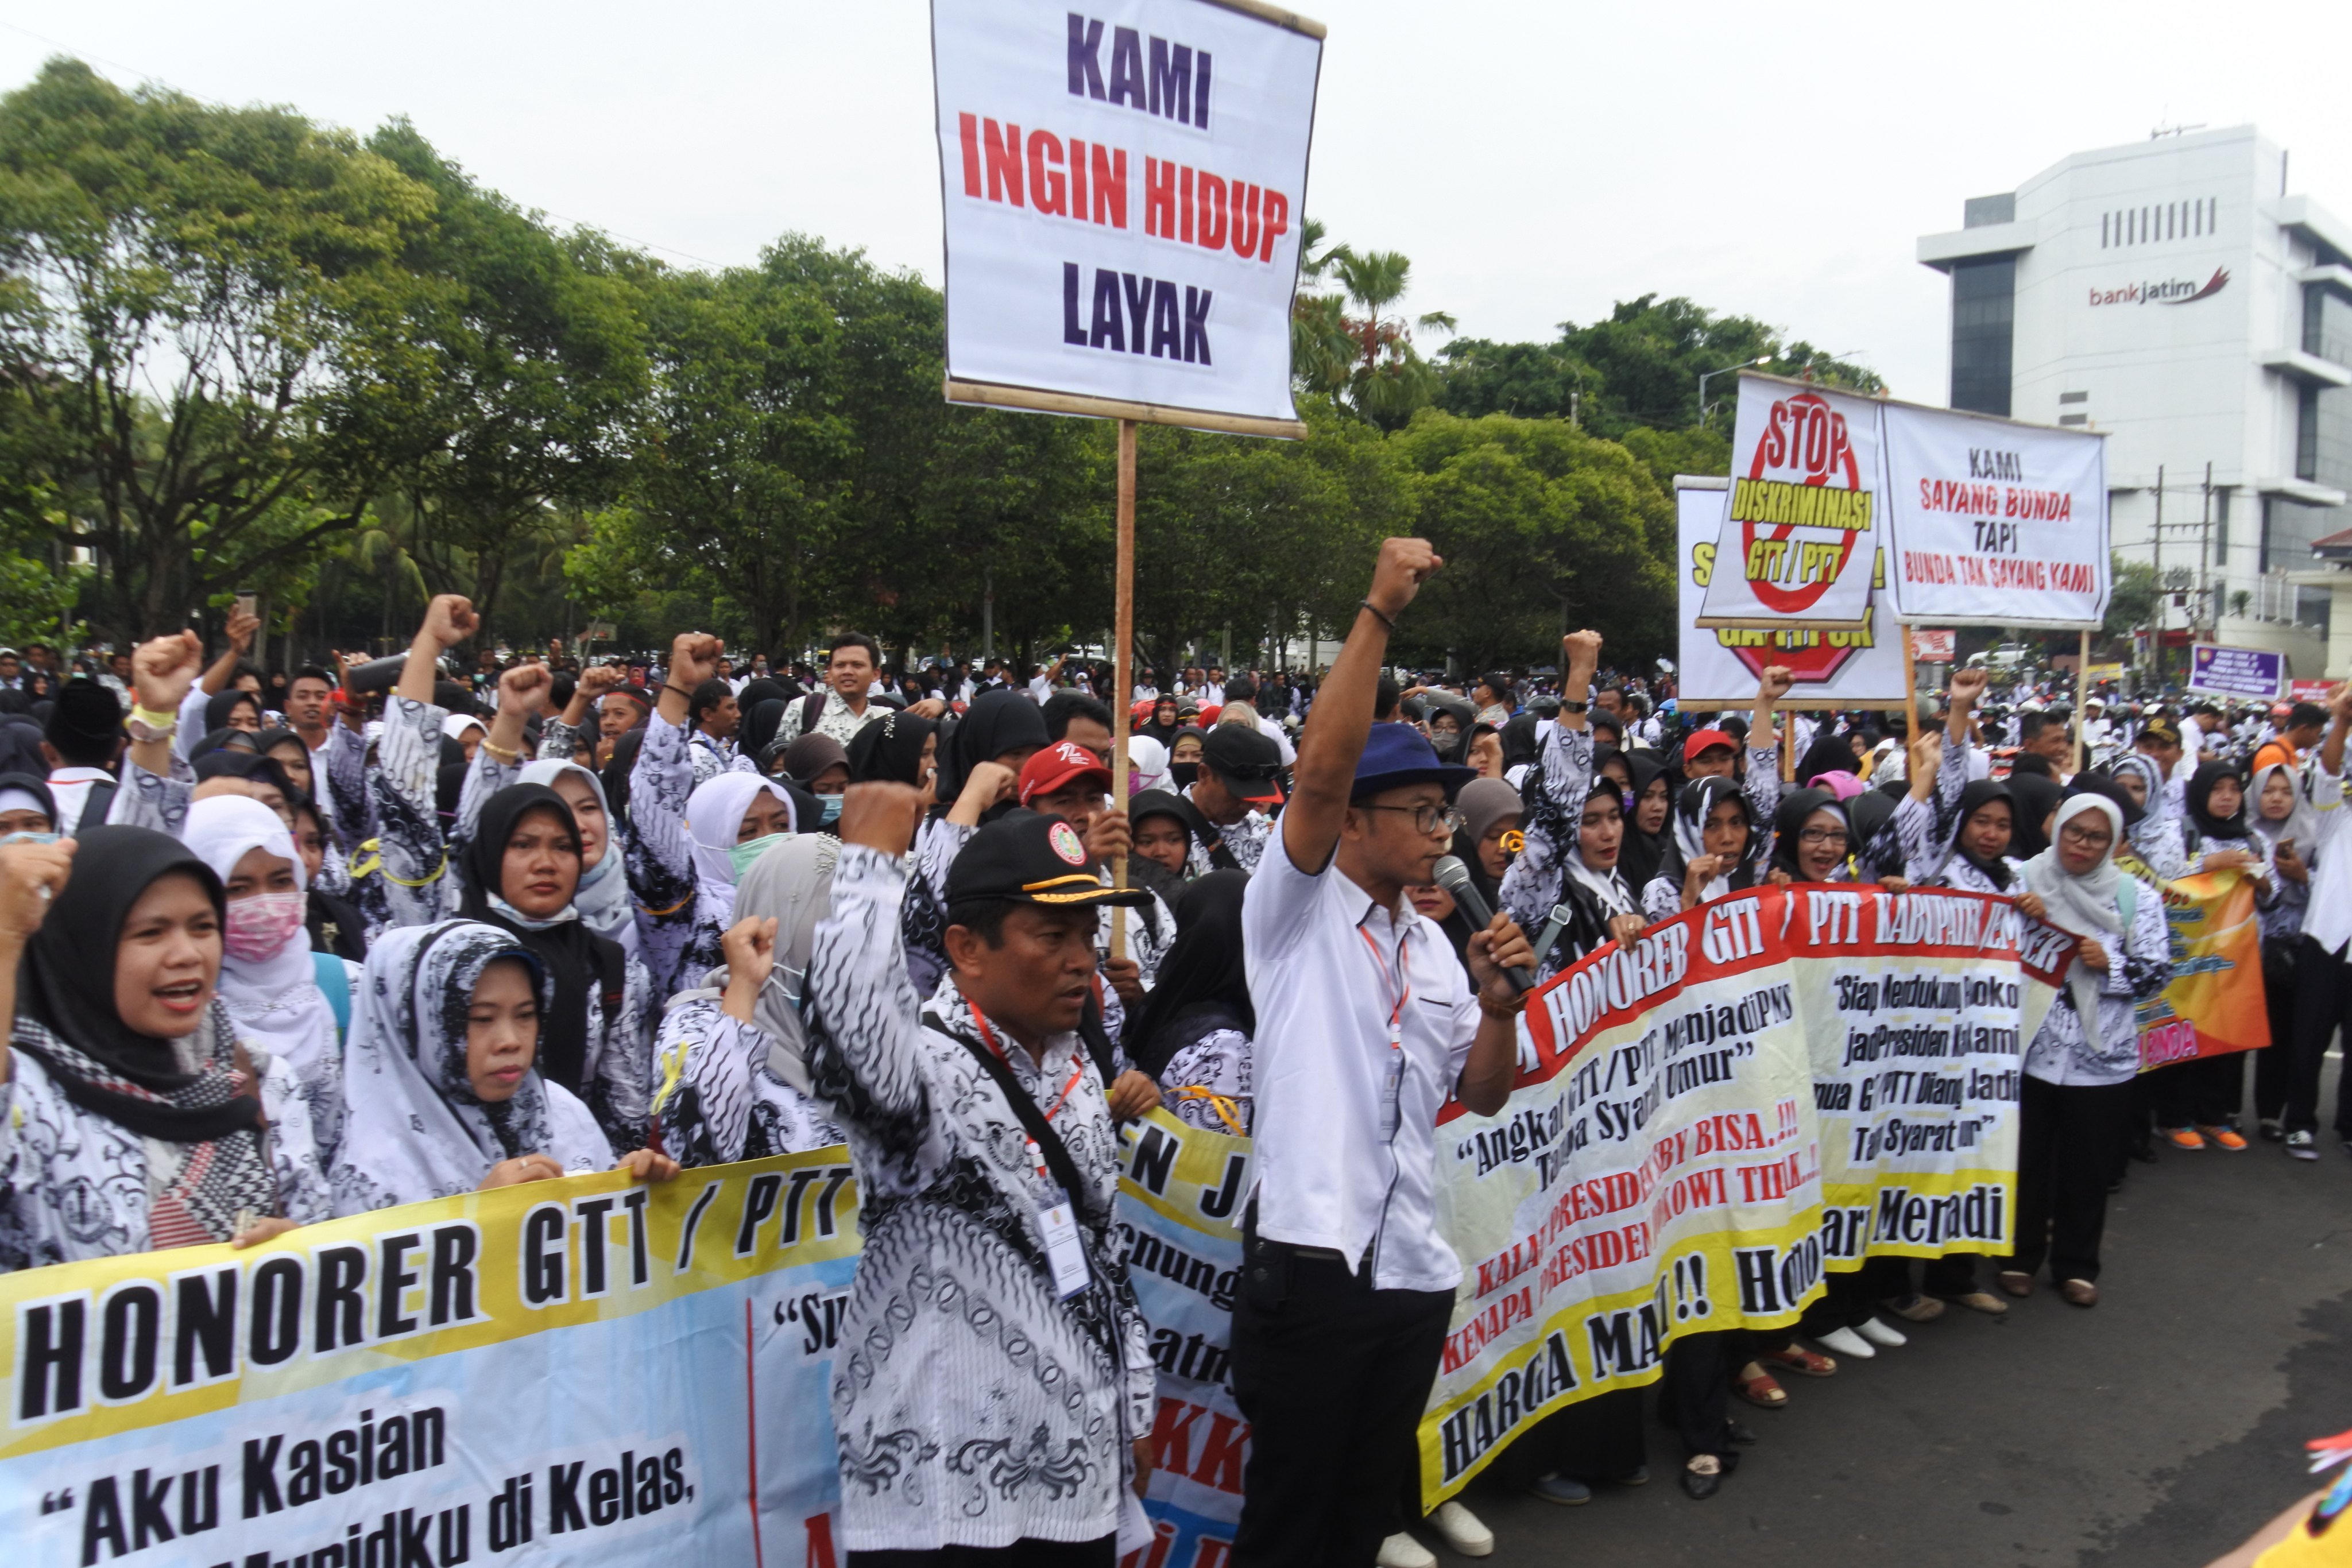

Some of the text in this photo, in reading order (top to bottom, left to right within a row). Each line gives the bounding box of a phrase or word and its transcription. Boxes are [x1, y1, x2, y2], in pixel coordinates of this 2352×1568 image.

[1067, 11, 1212, 130] KAMI
[958, 111, 1289, 264] INGIN HIDUP
[1063, 261, 1212, 366] LAYAK
[2090, 277, 2196, 307] bankjatim
[1766, 401, 1848, 474] STOP
[1969, 447, 2022, 482] KAMI
[1730, 477, 1871, 531] DISKRIMINASI
[1920, 478, 2072, 522] SAYANG BUNDA
[1745, 537, 1789, 582] GTT
[1800, 541, 1844, 584] PTT
[1904, 550, 2094, 594] BUNDA TAK SAYANG KAMI
[1974, 521, 2017, 554] TAPI
[1702, 896, 1765, 965] GTT
[1807, 891, 1862, 946] PTT
[1884, 1118, 1957, 1156] Syarat
[20, 1223, 478, 1421] HONORER
[523, 1190, 649, 1311] GTT
[678, 1184, 719, 1270] /
[738, 1167, 854, 1253] PTT
[1443, 1286, 1533, 1376] KENAPA
[1440, 1329, 1576, 1483] HARGA
[40, 1407, 444, 1568] “Aku Kasian
[489, 1473, 533, 1553] di
[550, 1447, 695, 1535] Kelas,
